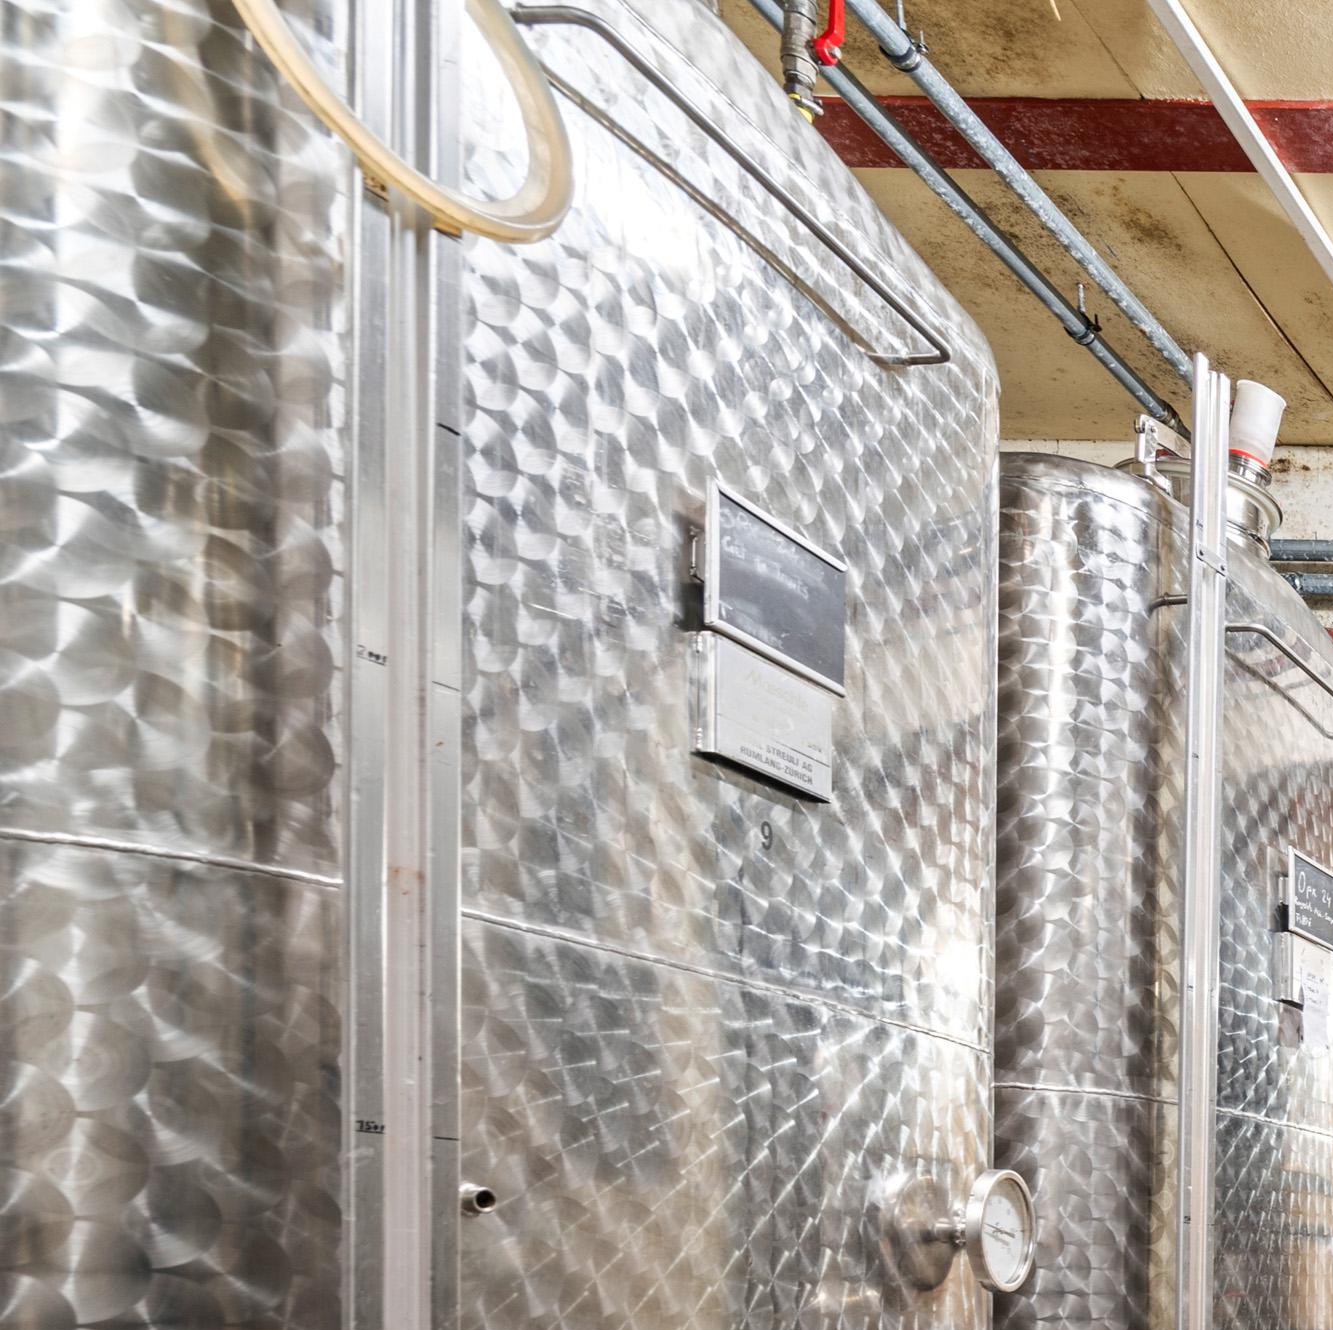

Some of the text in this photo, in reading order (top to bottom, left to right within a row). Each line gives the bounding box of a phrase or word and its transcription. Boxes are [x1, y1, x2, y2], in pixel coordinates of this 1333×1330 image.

[766, 744, 813, 773] STREULI AG
[760, 821, 773, 850] 9
